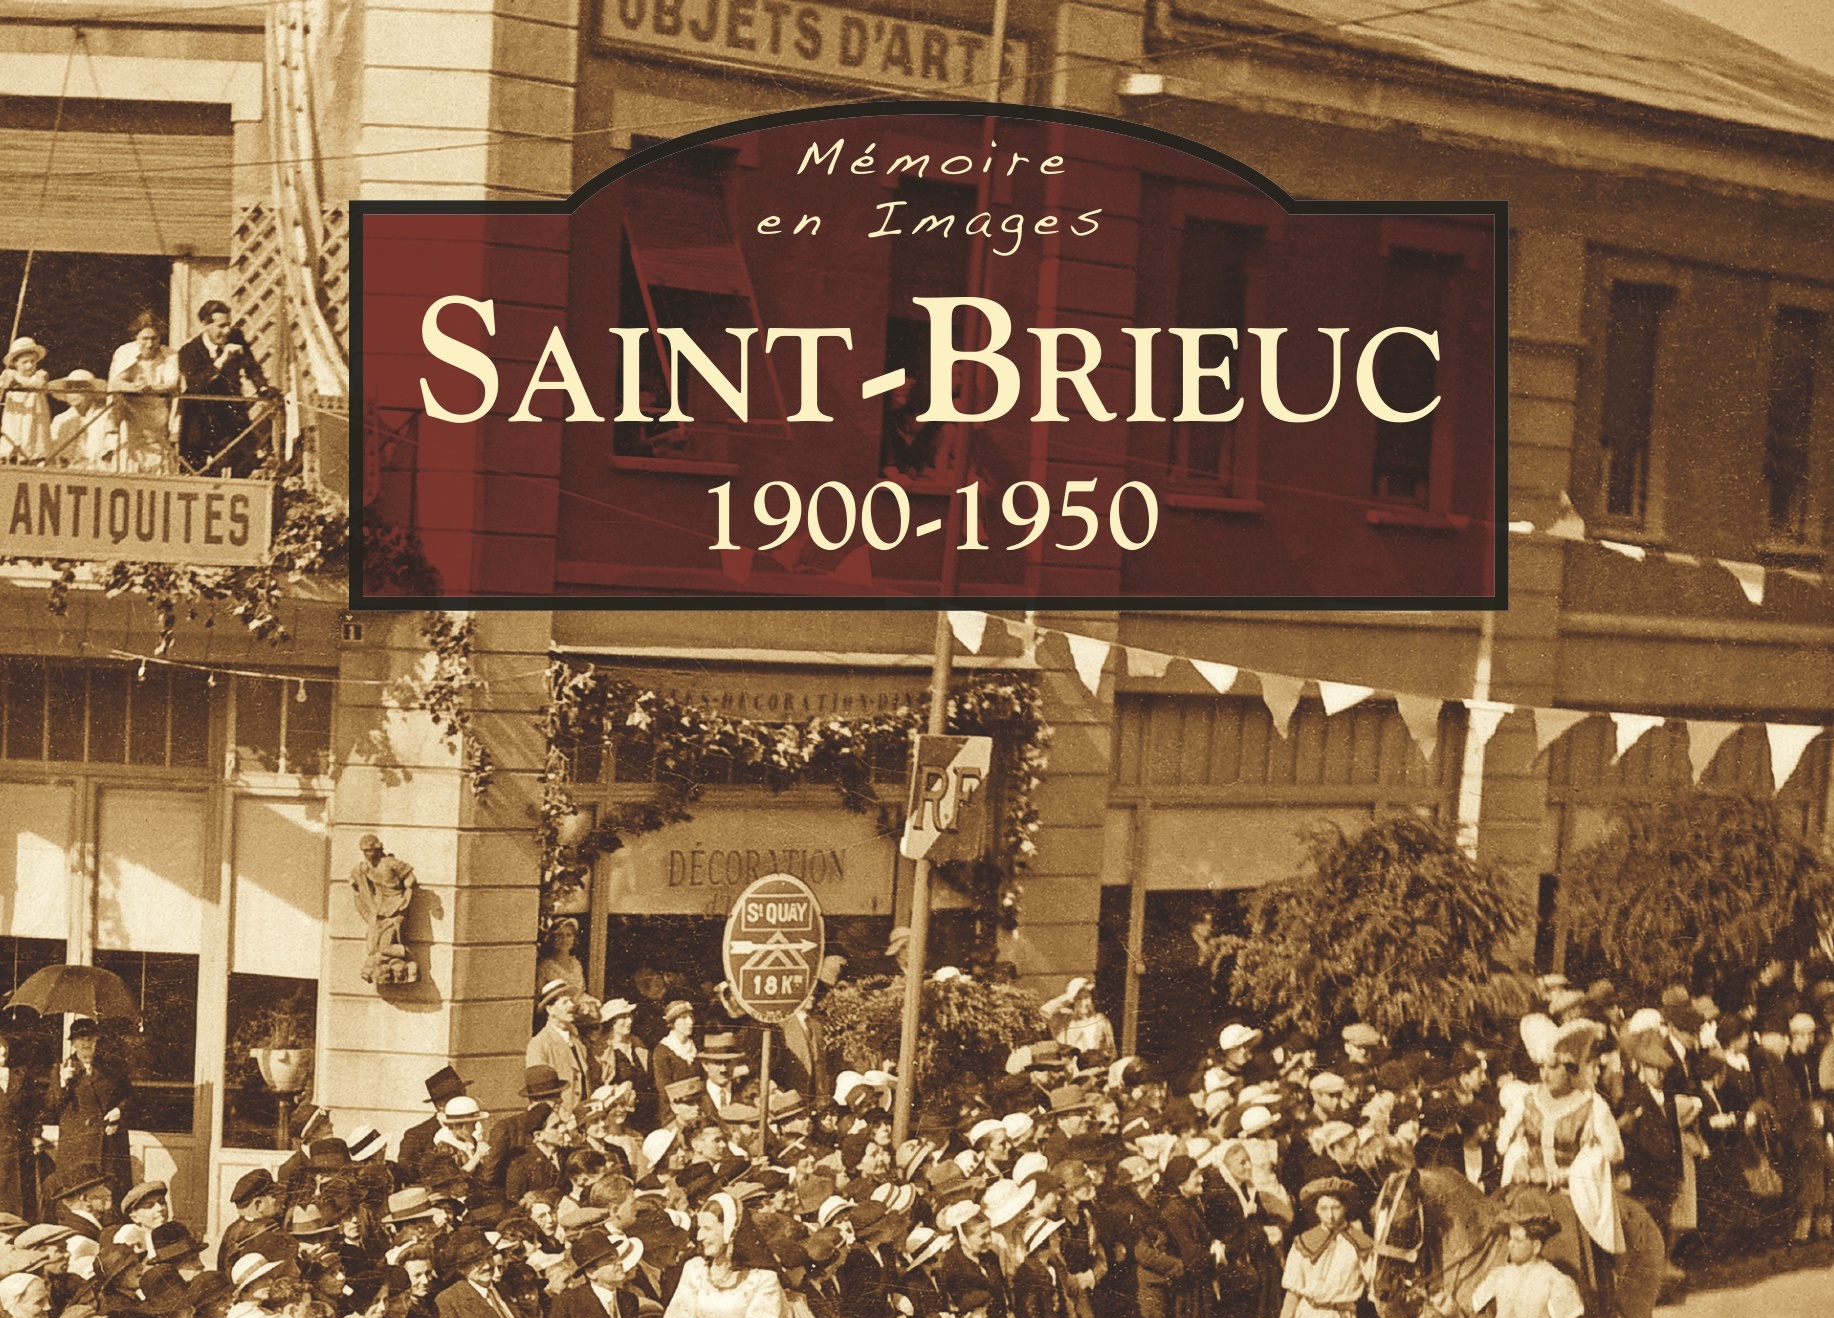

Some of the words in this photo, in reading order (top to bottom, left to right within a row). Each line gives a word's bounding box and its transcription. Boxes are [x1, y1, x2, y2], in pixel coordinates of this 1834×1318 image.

[617, 0, 822, 61] OBJETS
[9, 482, 250, 547] ANTIQUITÉS
[668, 841, 846, 888] DÉCORATION
[765, 902, 808, 925] QUAY
[753, 974, 778, 996] 18
